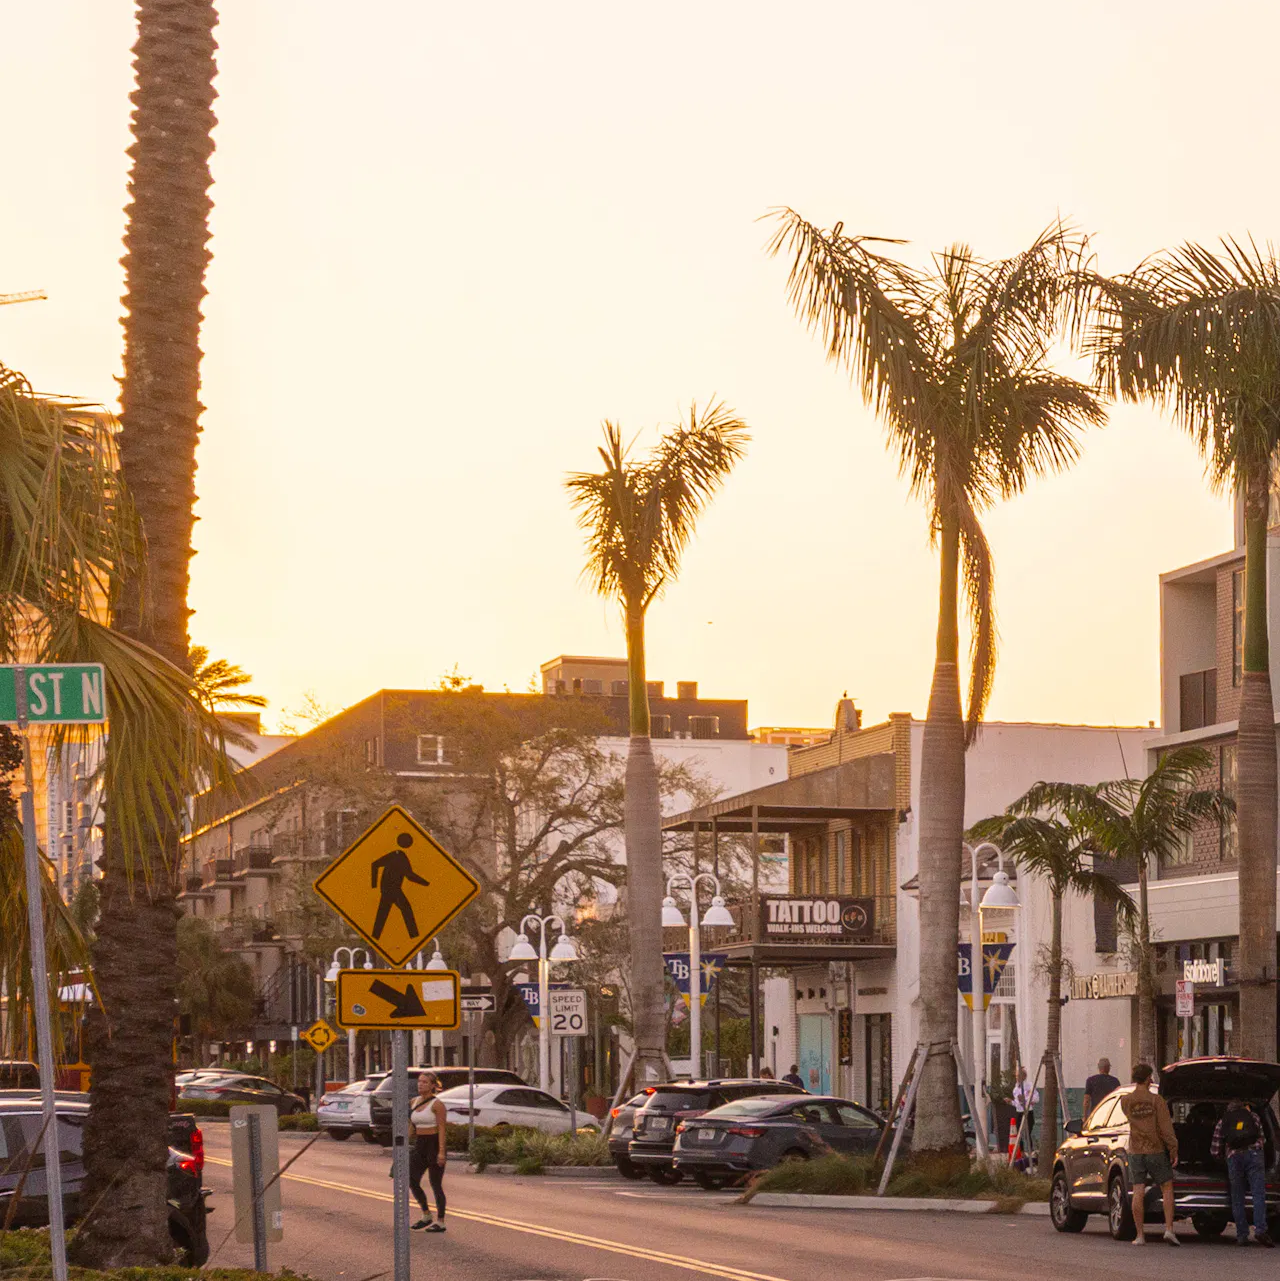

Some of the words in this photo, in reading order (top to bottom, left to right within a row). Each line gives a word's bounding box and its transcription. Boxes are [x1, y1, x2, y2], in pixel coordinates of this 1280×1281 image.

[29, 672, 64, 715] ST
[81, 672, 101, 714] N
[766, 900, 840, 924] TATTOO
[767, 924, 805, 934] WALK-INS
[805, 924, 843, 934] WELCOME
[668, 959, 690, 980] TB
[958, 954, 971, 976] B
[521, 987, 539, 1005] TB
[552, 995, 582, 1003] SPEED
[553, 1013, 584, 1030] 20
